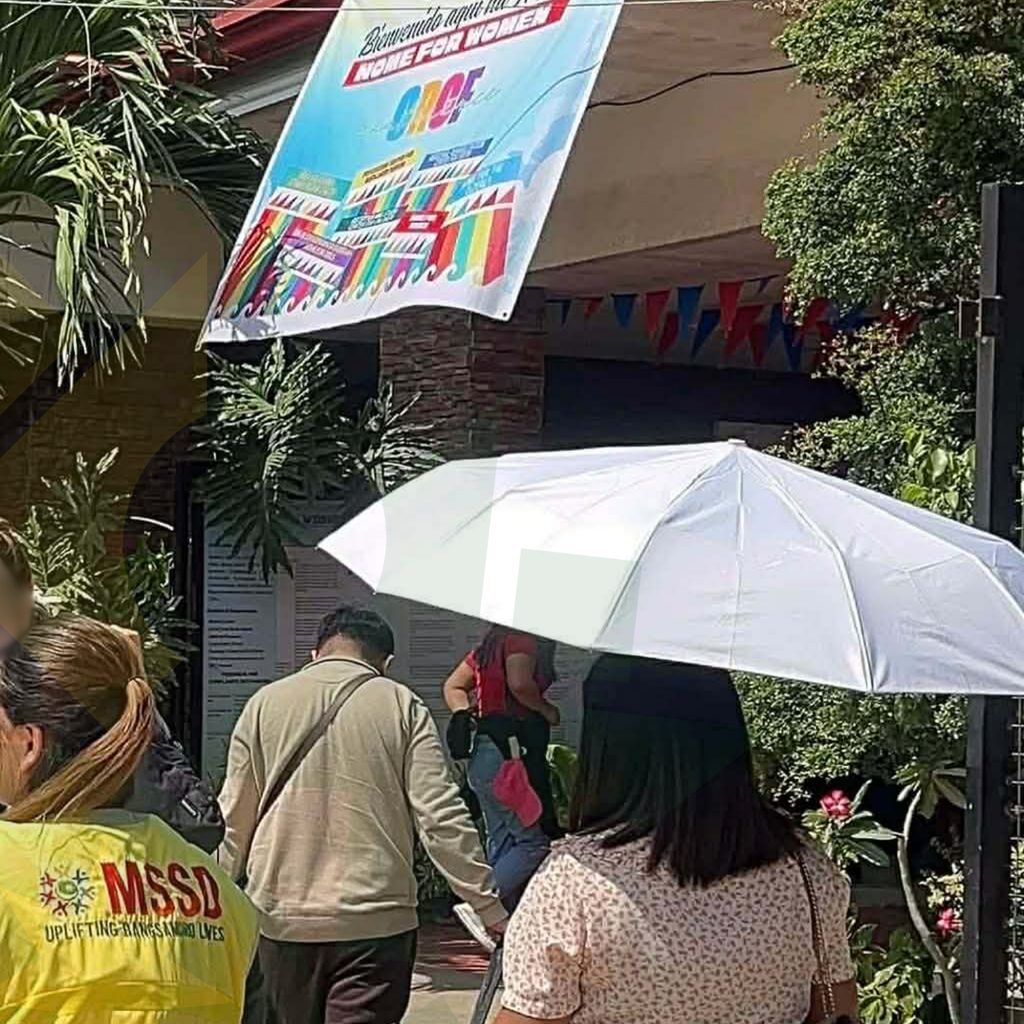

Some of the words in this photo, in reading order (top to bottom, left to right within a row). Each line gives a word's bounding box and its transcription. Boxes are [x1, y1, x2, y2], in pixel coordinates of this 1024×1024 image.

[354, 50, 418, 81] HOME
[414, 33, 465, 64] FOR
[464, 5, 551, 48] WOMEN
[358, 6, 442, 58] Bienvenido
[101, 860, 223, 920] MSSD
[44, 920, 119, 943] UPLIFTING
